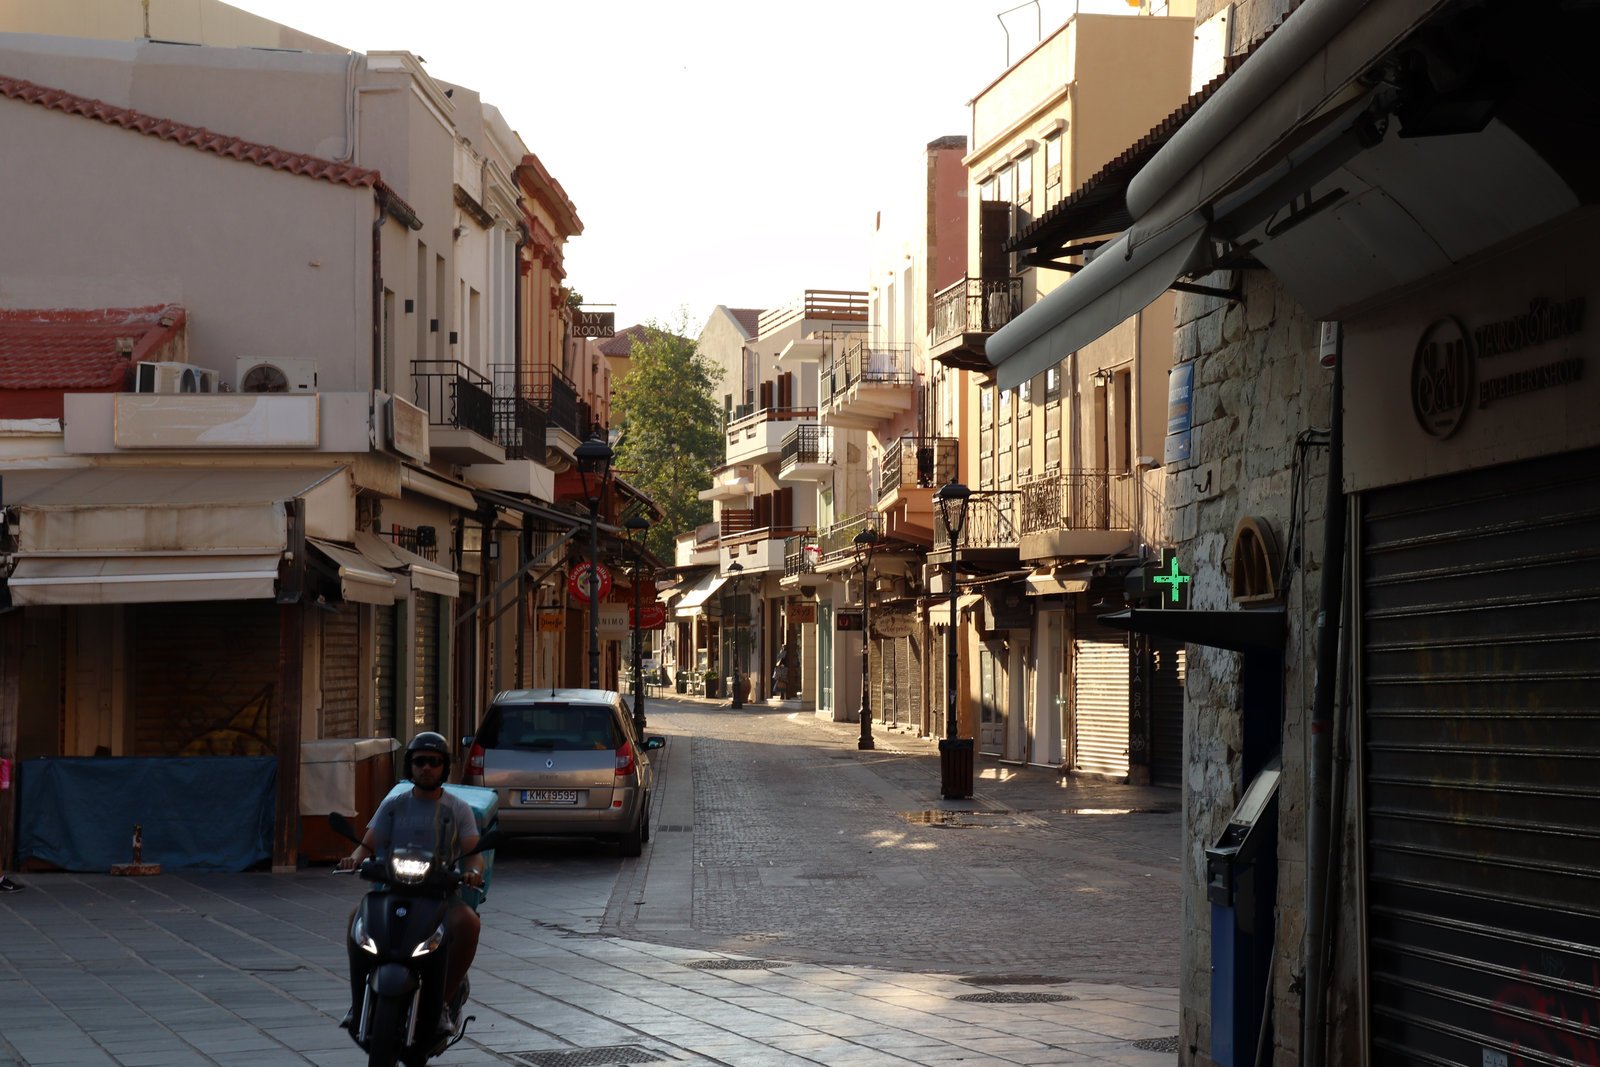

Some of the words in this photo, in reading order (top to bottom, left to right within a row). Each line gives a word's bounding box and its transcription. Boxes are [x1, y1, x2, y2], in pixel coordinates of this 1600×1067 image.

[573, 325, 614, 336] ROOMS
[581, 313, 603, 324] MY
[1541, 299, 1581, 340] MARY
[1543, 359, 1581, 388] SHOP
[1133, 632, 1142, 683] PIVITA
[1133, 691, 1142, 719] SPA
[529, 791, 547, 800] KMK
[551, 791, 575, 800] 9595
